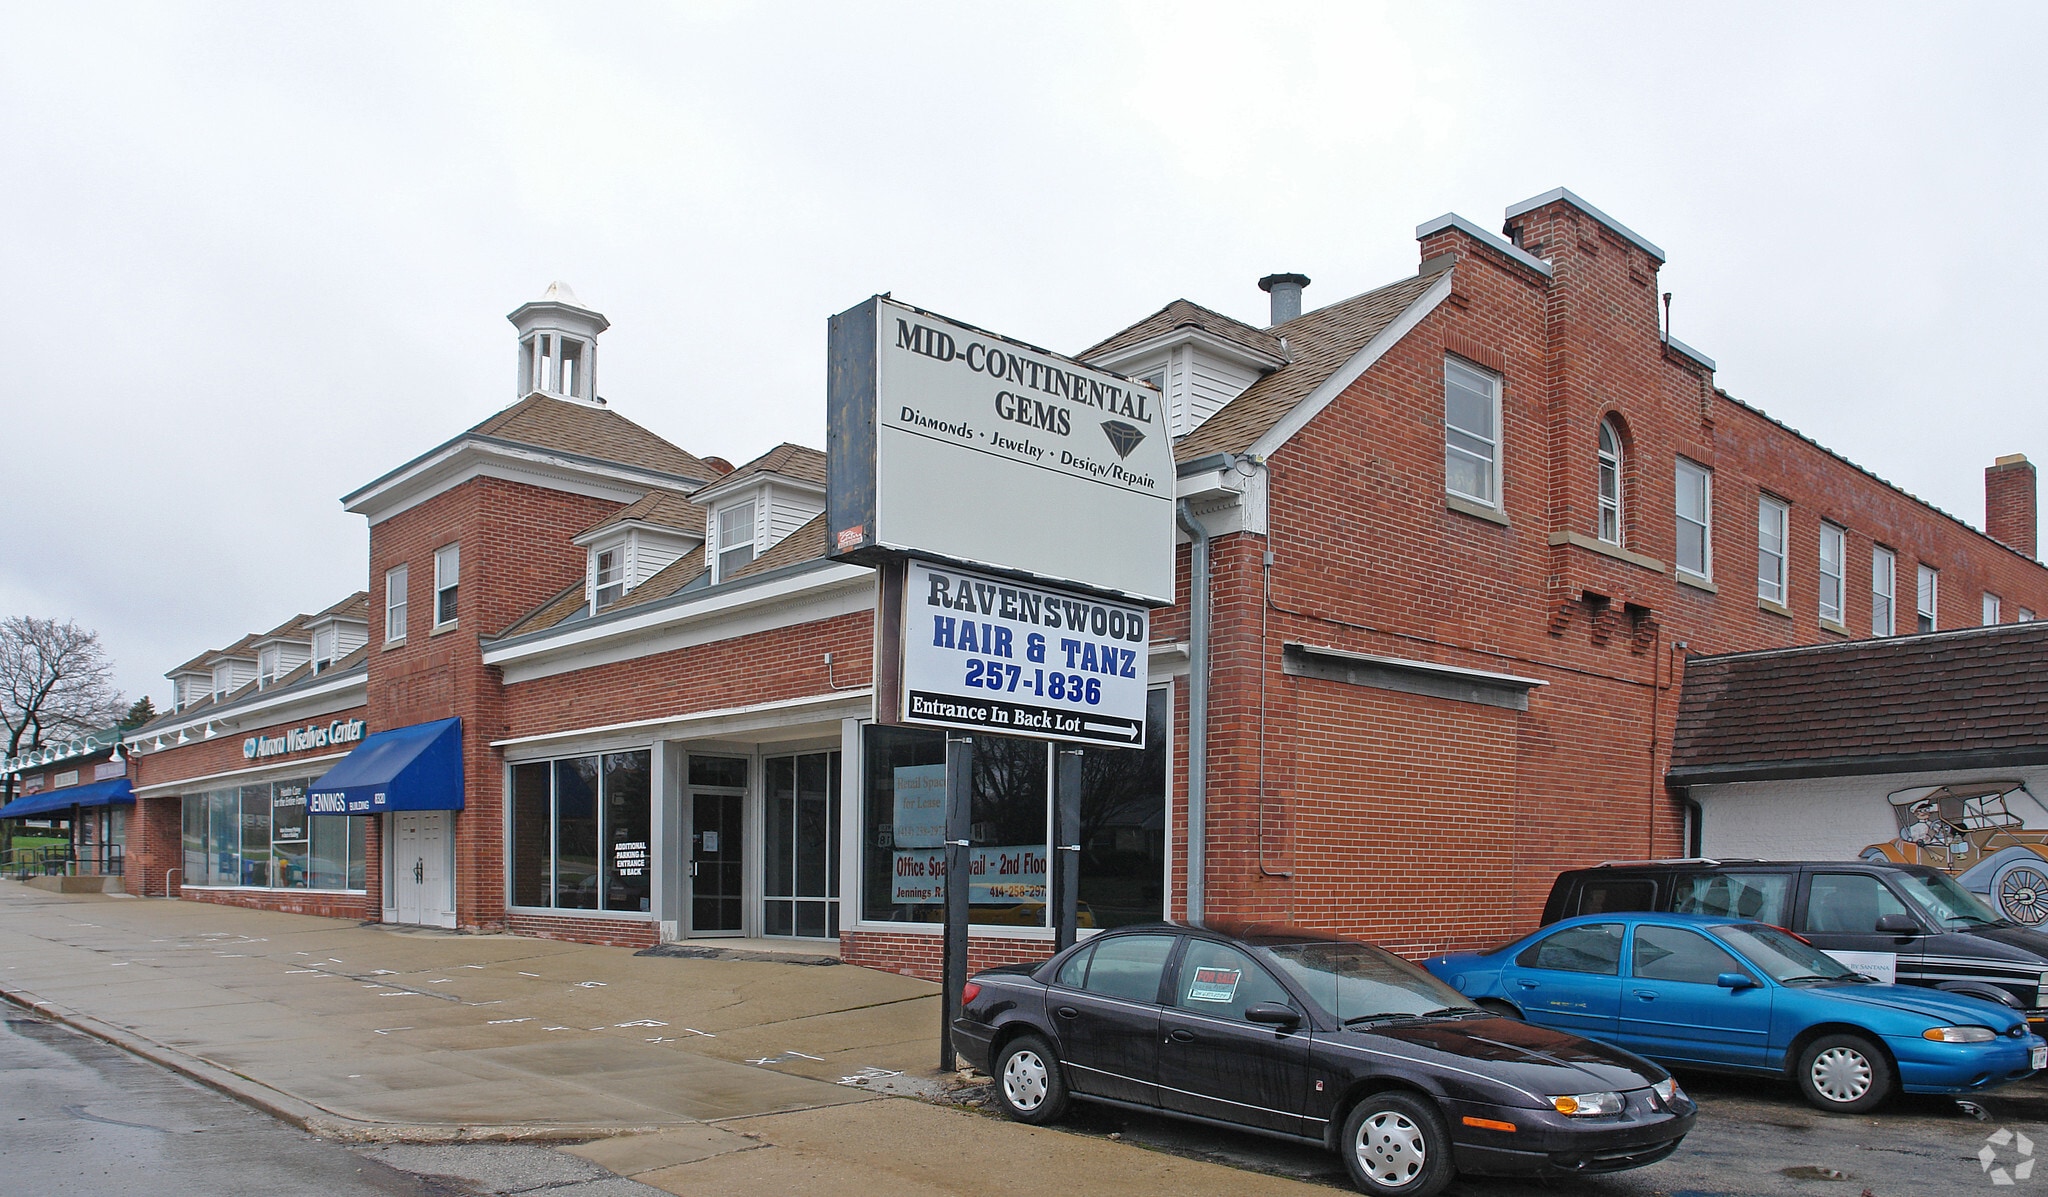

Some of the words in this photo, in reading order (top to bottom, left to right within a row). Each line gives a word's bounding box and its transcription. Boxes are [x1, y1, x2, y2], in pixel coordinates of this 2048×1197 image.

[895, 318, 1152, 424] MID-CONTINENTAL
[994, 390, 1071, 437] GEMS
[900, 406, 973, 439] Diamonds
[990, 431, 1044, 461] Jewelry
[1060, 450, 1155, 489] Design/Repair
[927, 572, 1144, 643] RAVENSWOOD
[933, 614, 1013, 659] HAIR
[1026, 632, 1046, 664] &
[1060, 637, 1136, 679] TANZ
[965, 658, 1101, 705] 257-1836
[912, 696, 987, 720] Entrance
[991, 705, 1009, 723] In
[1013, 708, 1052, 728] Back
[1055, 714, 1081, 732] Lot
[257, 736, 287, 756] Aurora
[287, 725, 329, 752] Wiselives
[328, 718, 366, 744] Center
[897, 776, 921, 789] Retail
[310, 792, 345, 812] JENNINGS
[349, 801, 370, 811] BUILDING
[903, 797, 915, 809] for
[917, 796, 941, 809] Lease
[615, 842, 646, 850] ADDITIONAL
[616, 851, 640, 859] PARKING
[617, 859, 645, 867] ENTRANCE
[620, 868, 627, 876] IN
[627, 868, 642, 876] BACK
[897, 856, 925, 877] Office
[1000, 853, 1019, 874] 2nd
[1024, 852, 1046, 874] Floo
[897, 887, 931, 900] Jennings
[990, 885, 1046, 898] 414-258-297
[1197, 970, 1216, 982] FOR
[1216, 972, 1238, 984] SALE
